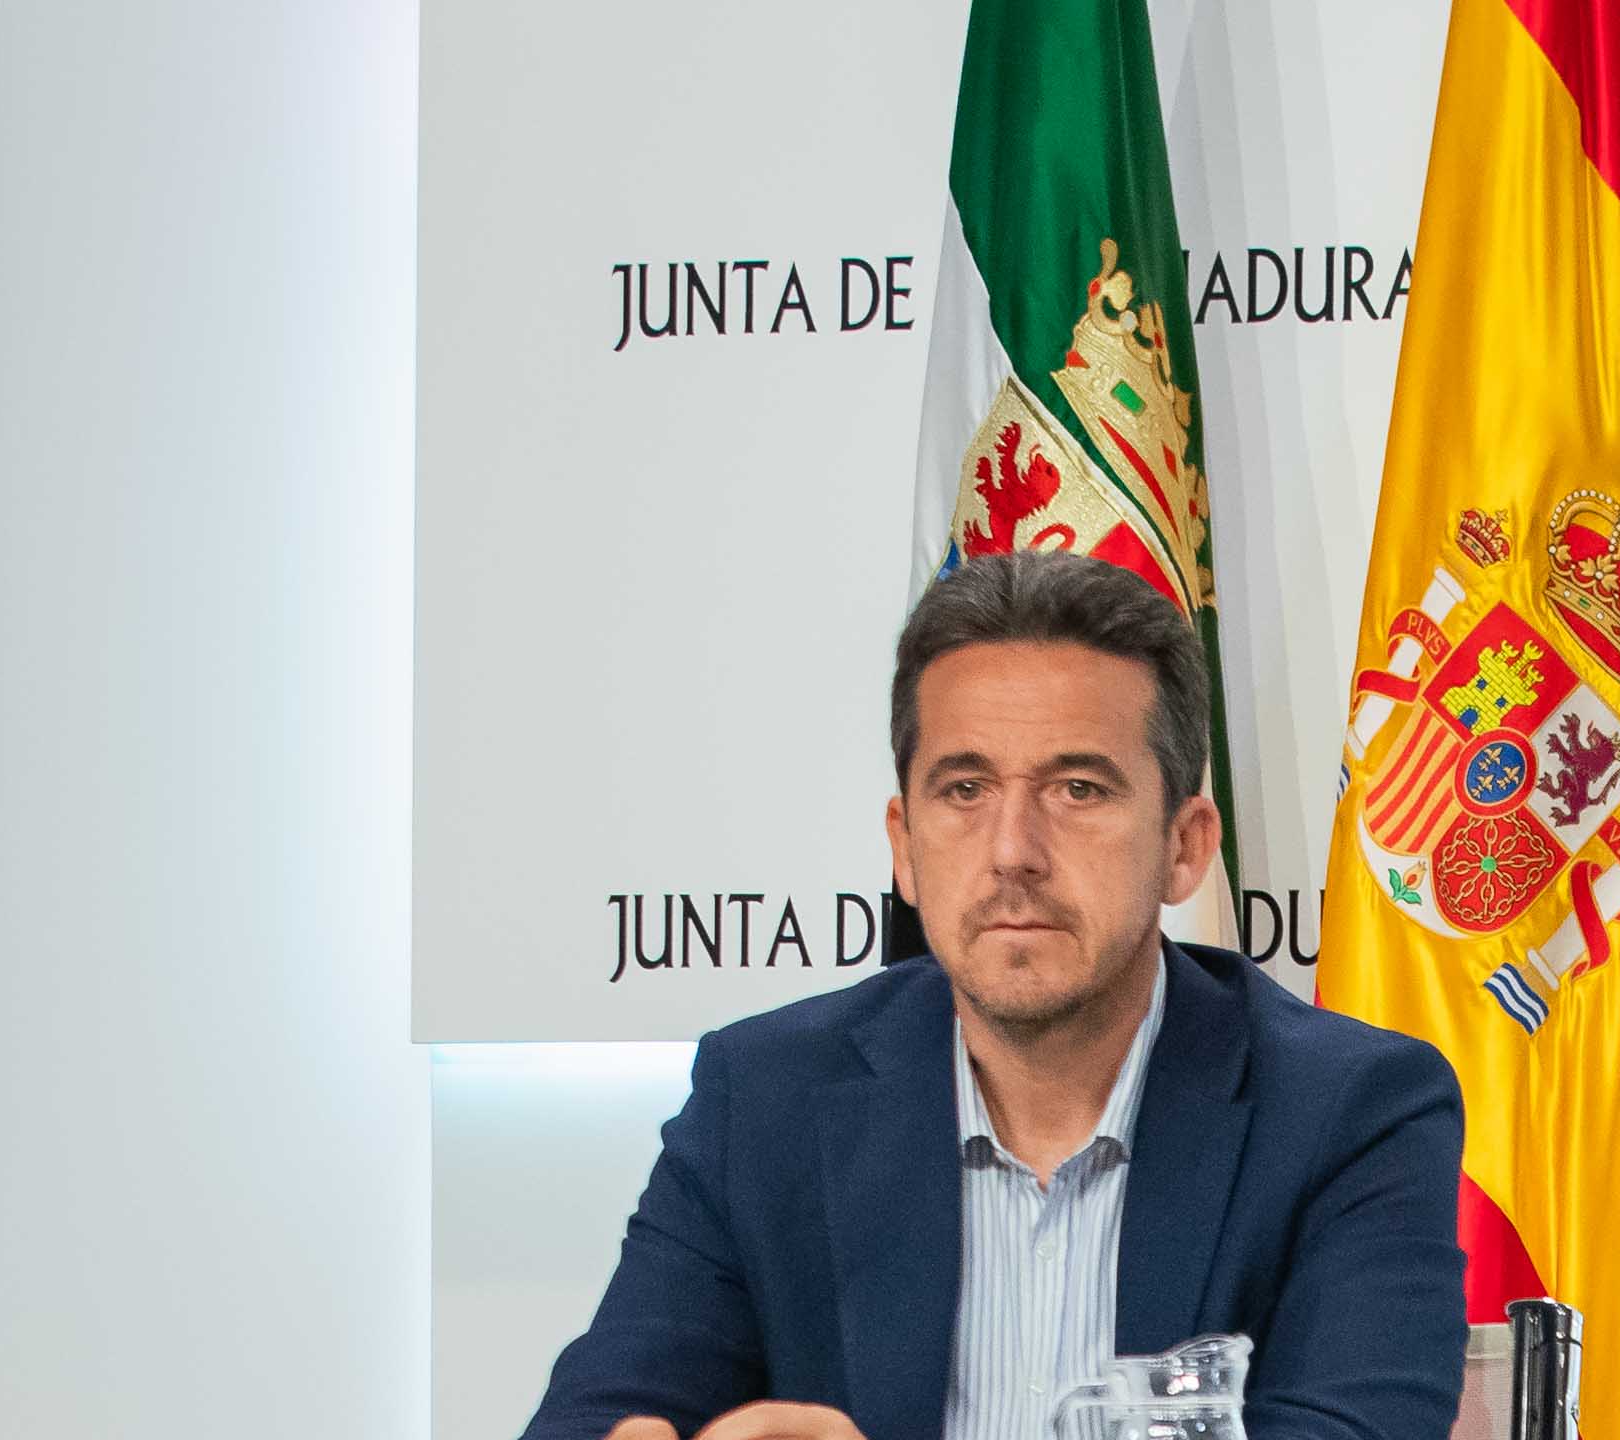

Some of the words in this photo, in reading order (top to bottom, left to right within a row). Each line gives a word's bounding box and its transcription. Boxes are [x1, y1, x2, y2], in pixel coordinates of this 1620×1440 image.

[612, 261, 817, 351] JUNTA
[840, 256, 915, 332] DE
[1406, 611, 1446, 655] PLVS
[608, 894, 813, 983] JUNTA
